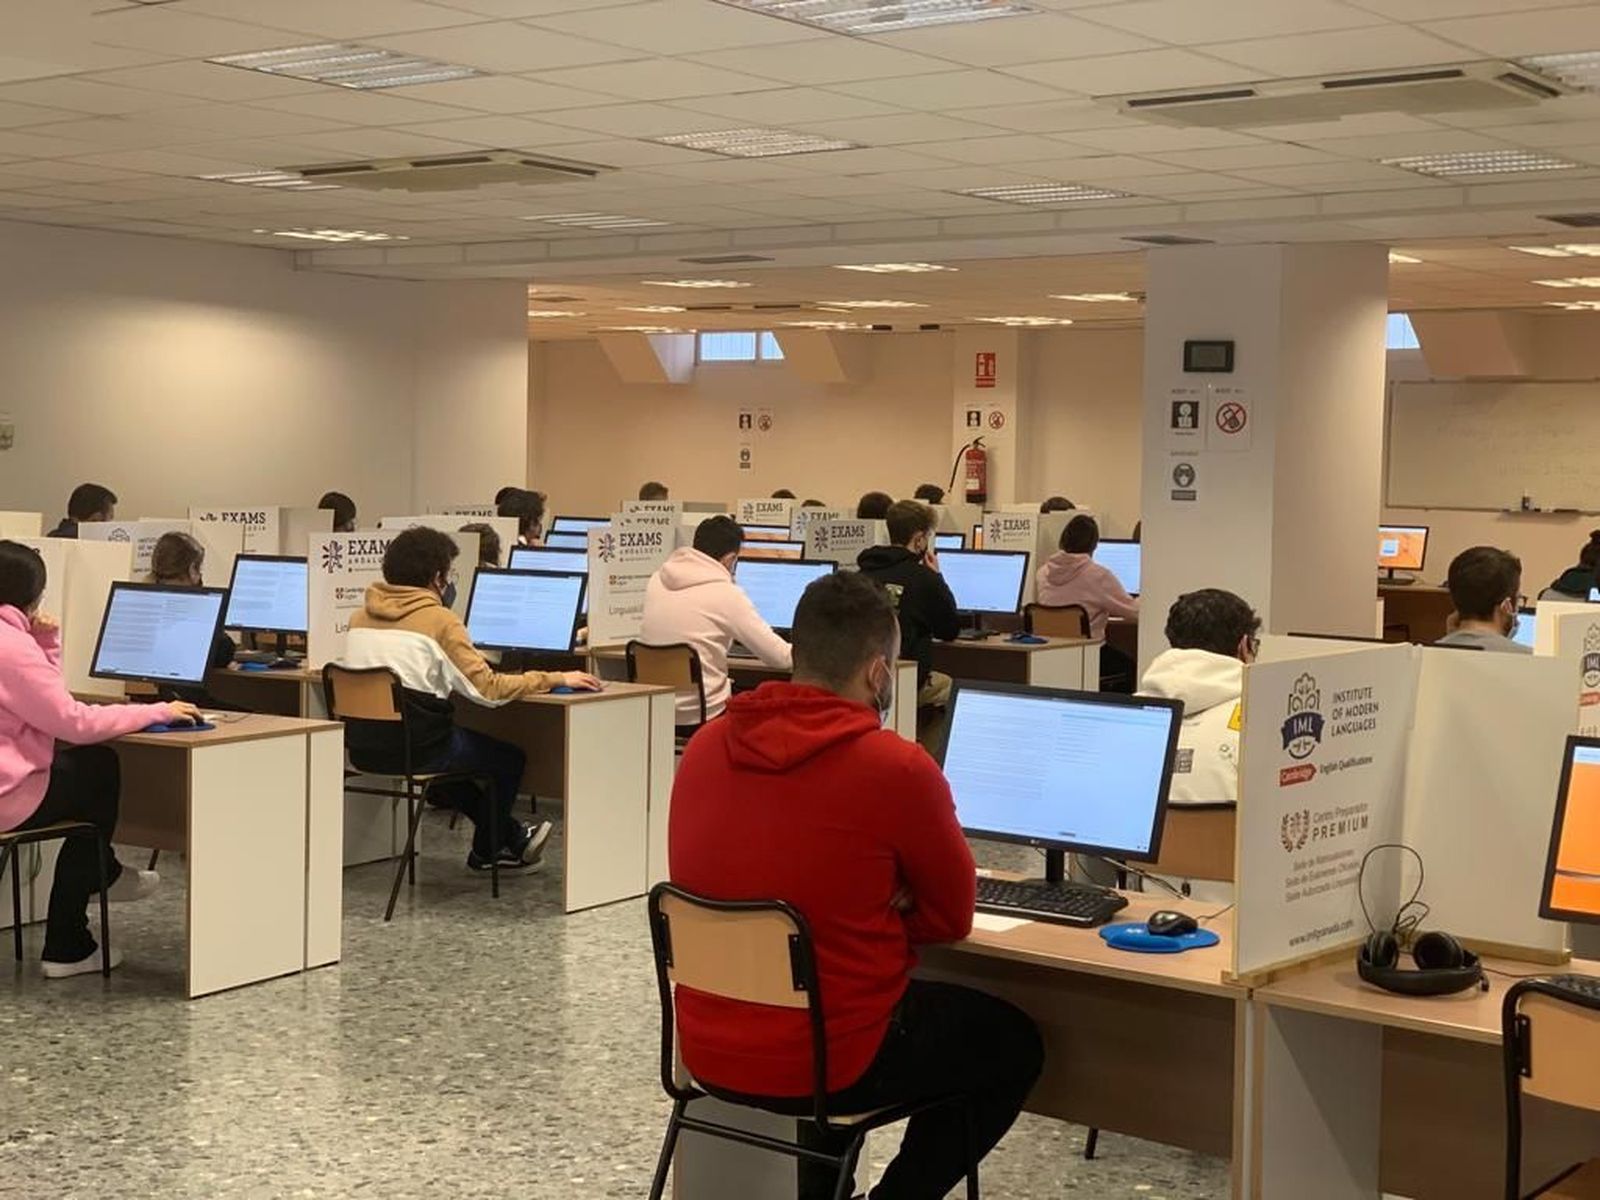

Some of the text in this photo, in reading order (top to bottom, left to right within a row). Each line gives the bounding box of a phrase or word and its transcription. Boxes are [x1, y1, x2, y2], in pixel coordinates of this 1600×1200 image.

[754, 502, 784, 513] EXAMS
[221, 512, 266, 524] EXAMS
[1003, 519, 1031, 530] EXAMS
[831, 525, 866, 538] EXAMS
[619, 532, 662, 547] EXAMS
[1333, 687, 1373, 703] INSTITUTE
[1332, 702, 1380, 721] OF MODERN
[1293, 716, 1314, 735] IML
[1331, 718, 1377, 737] LANGUAGES
[1312, 815, 1369, 841] PREMIUM
